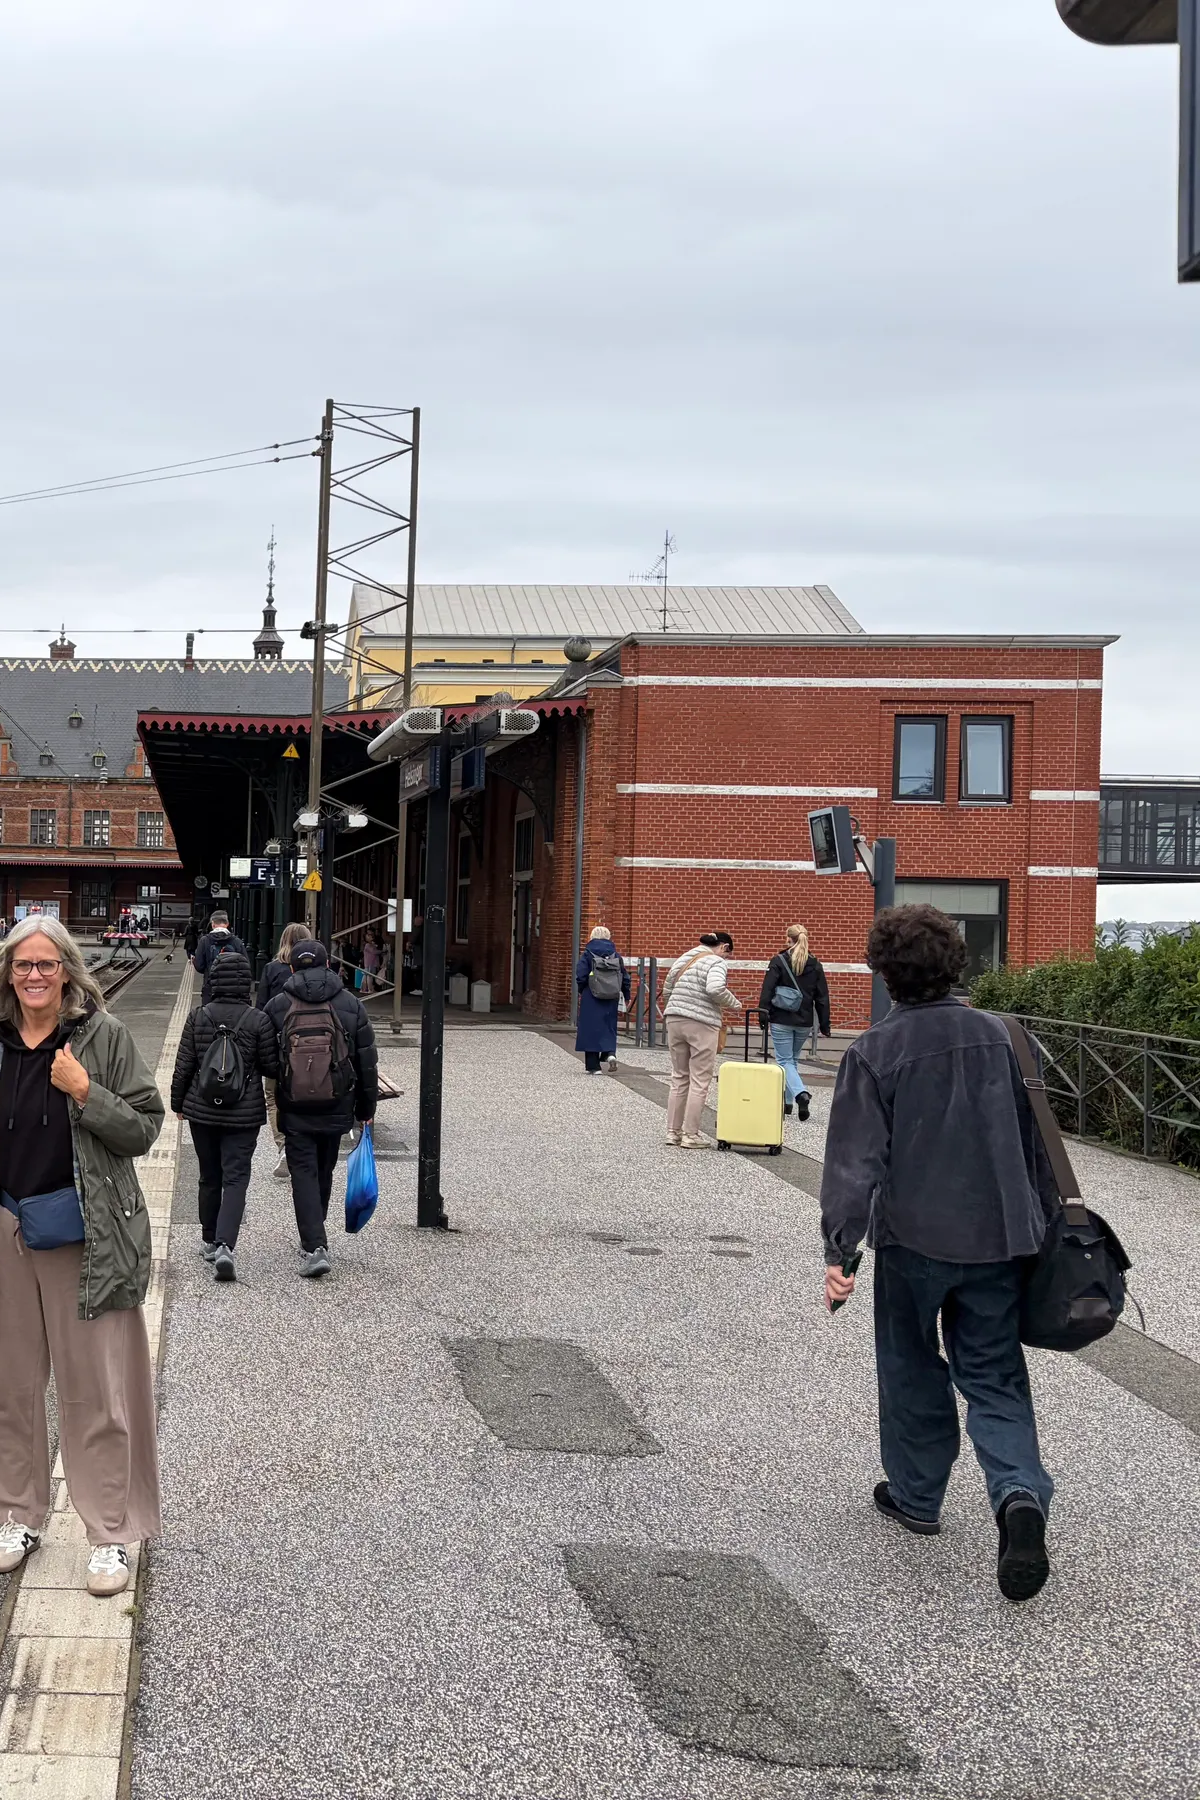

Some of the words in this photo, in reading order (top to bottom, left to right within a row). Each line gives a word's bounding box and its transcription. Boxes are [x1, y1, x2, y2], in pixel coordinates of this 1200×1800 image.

[257, 868, 266, 880] E
[269, 877, 276, 886] 1
[211, 883, 220, 893] S
